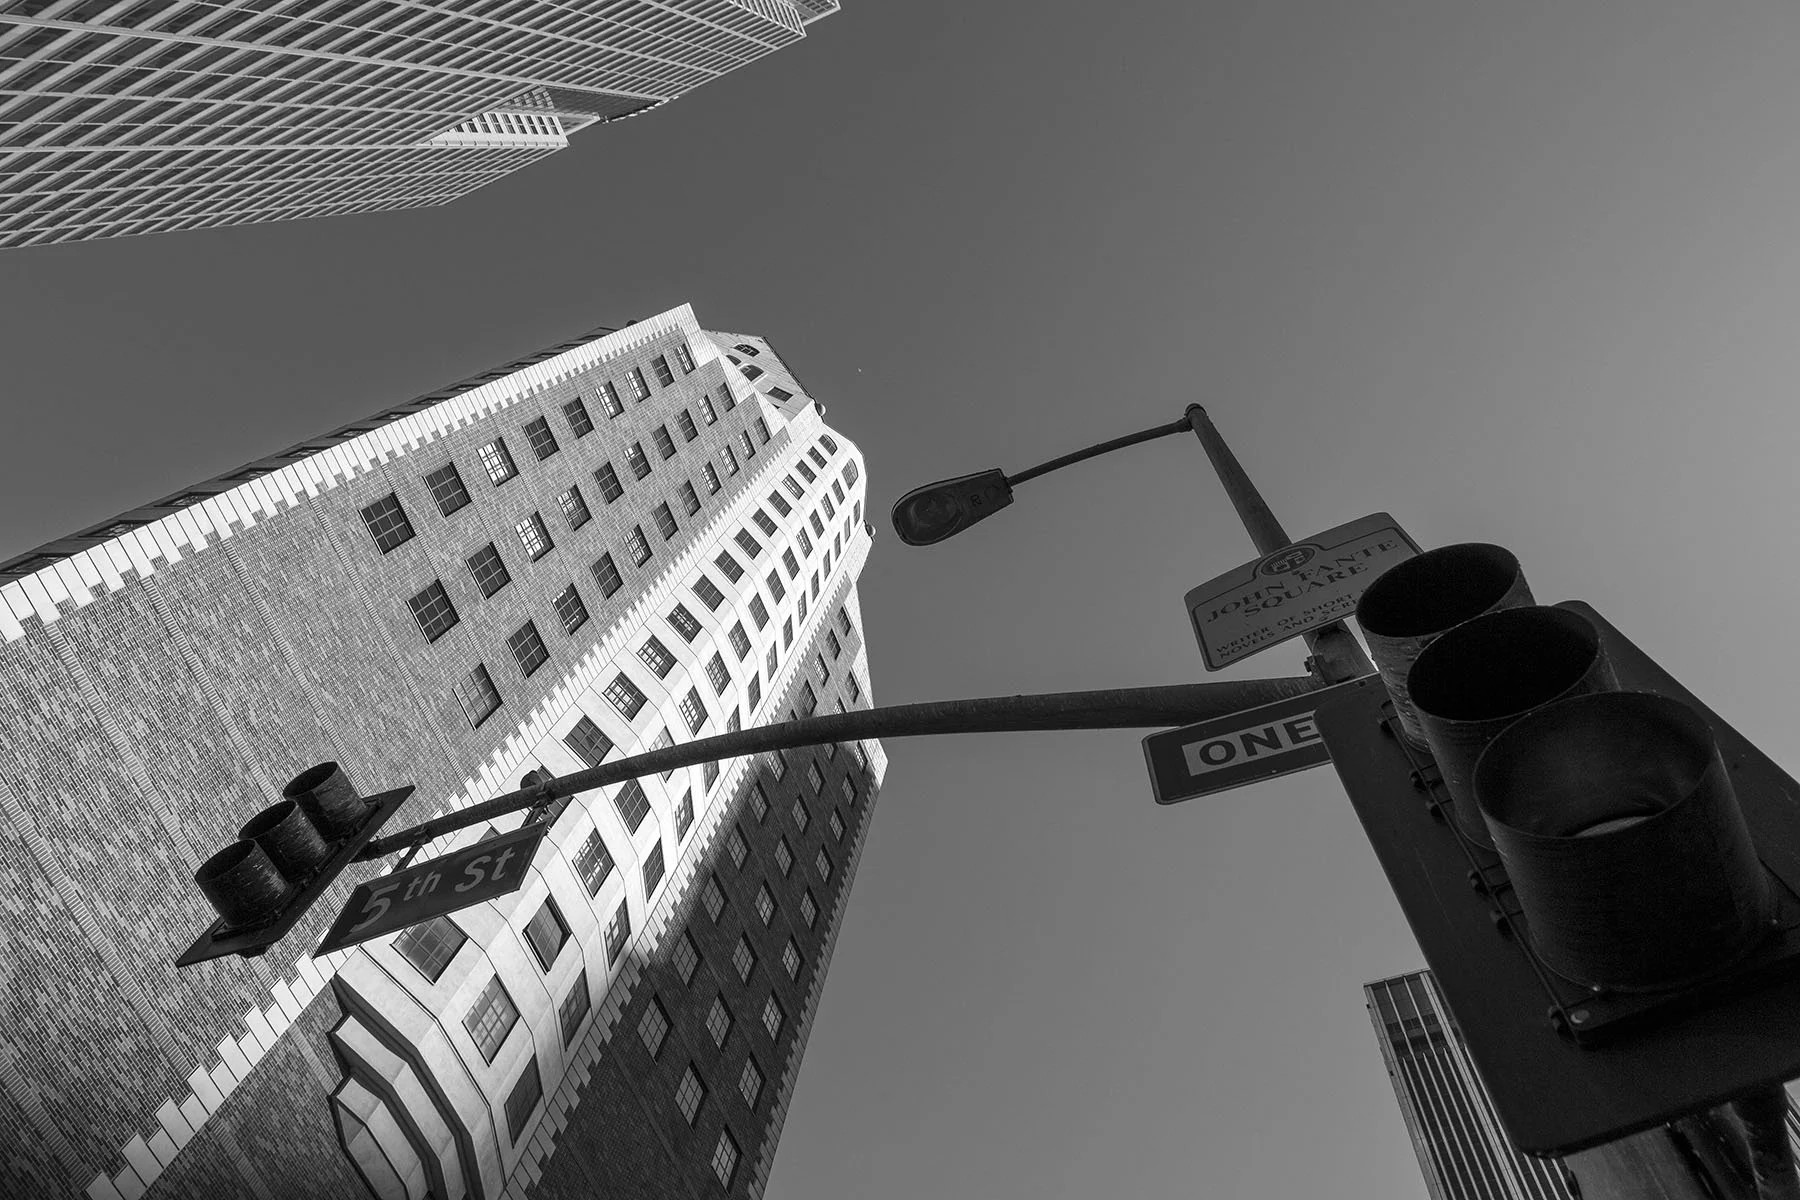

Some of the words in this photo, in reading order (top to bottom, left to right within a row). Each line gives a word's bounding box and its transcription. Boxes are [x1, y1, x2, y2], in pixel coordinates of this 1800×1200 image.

[1207, 581, 1285, 622] JOHN
[1299, 540, 1399, 582] FANTE
[1244, 563, 1370, 617] SQUARE
[1216, 626, 1270, 653] WRITER
[1277, 615, 1296, 627] OF
[1303, 593, 1353, 615] SHORT
[1219, 631, 1275, 659] NOVELS
[1282, 615, 1315, 632] AND
[1199, 715, 1321, 766] ONE
[348, 870, 442, 934] 5th
[455, 847, 516, 893] St
